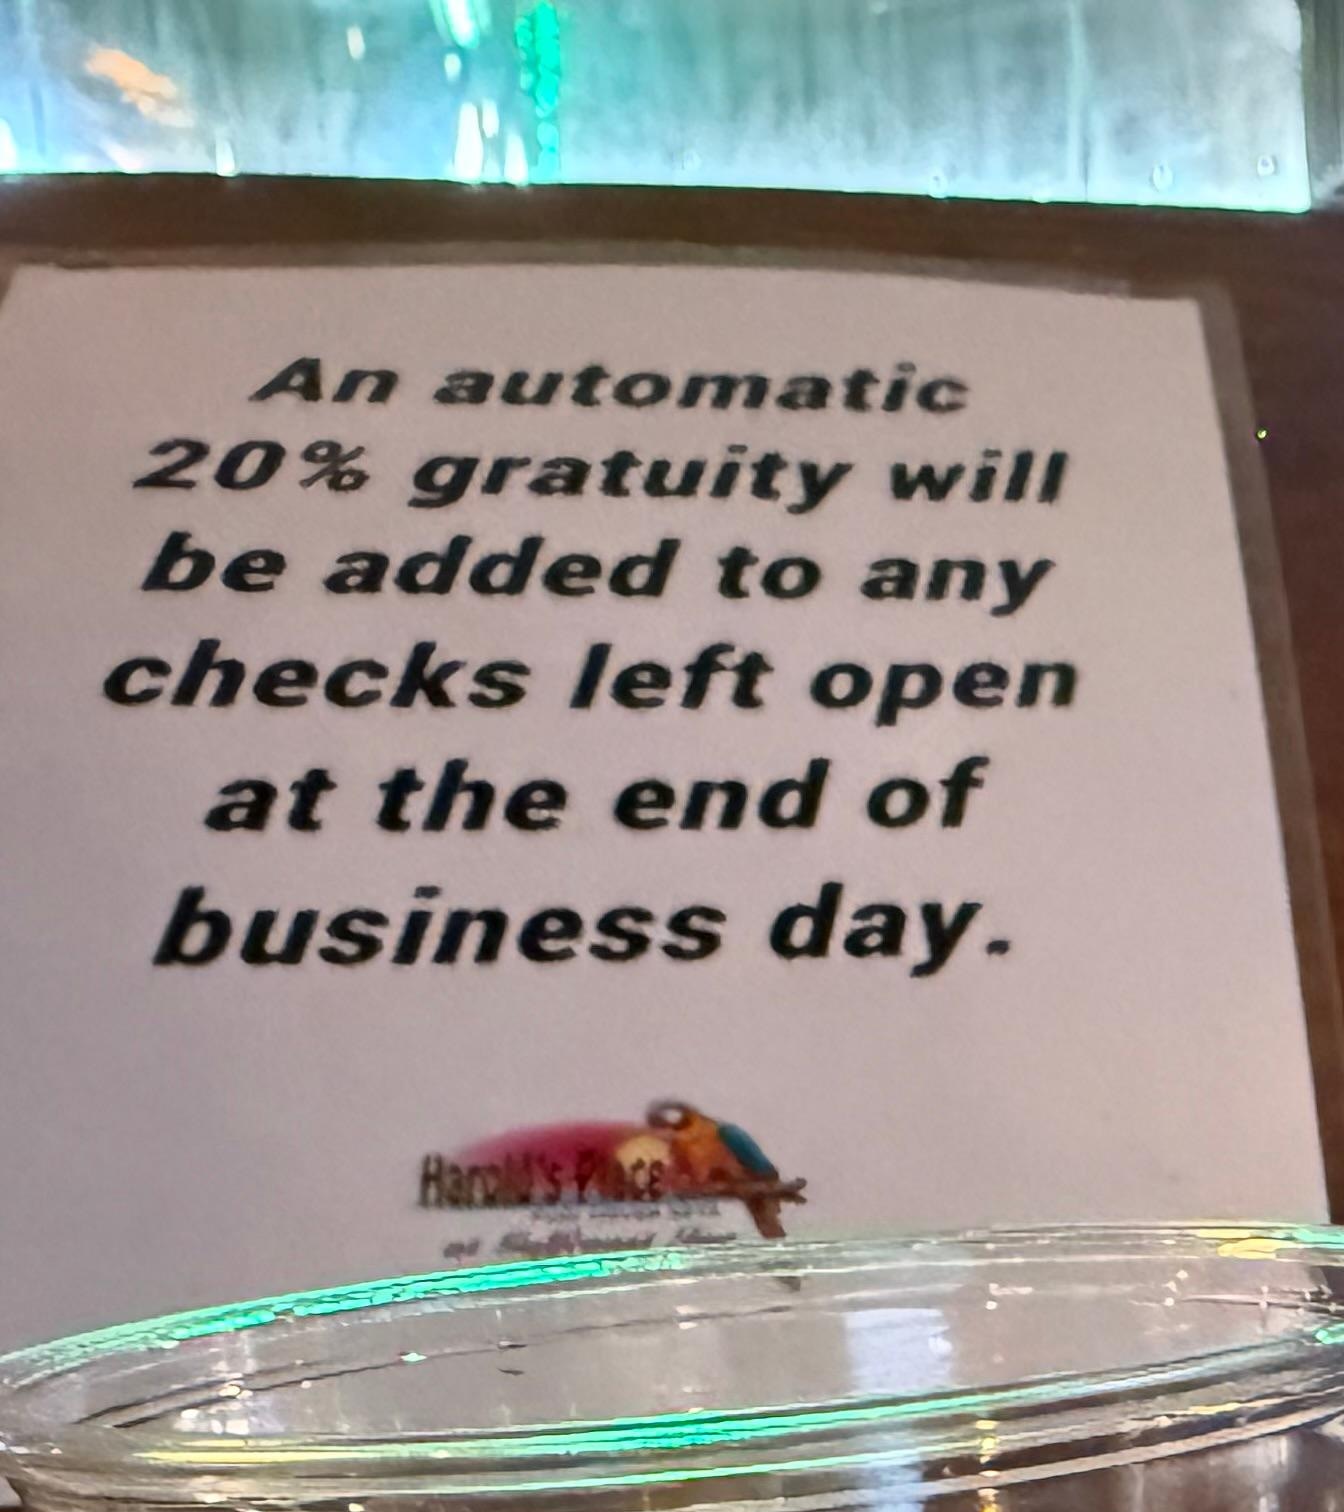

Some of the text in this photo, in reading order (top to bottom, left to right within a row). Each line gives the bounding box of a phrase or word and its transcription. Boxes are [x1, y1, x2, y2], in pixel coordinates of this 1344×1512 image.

[247, 355, 970, 415] An automatic
[131, 436, 1070, 516] 20% gratuity will
[139, 529, 1056, 618] be added to any
[101, 636, 1079, 729] checks left open
[202, 754, 991, 835] at the end of
[150, 880, 1011, 979] business day.
